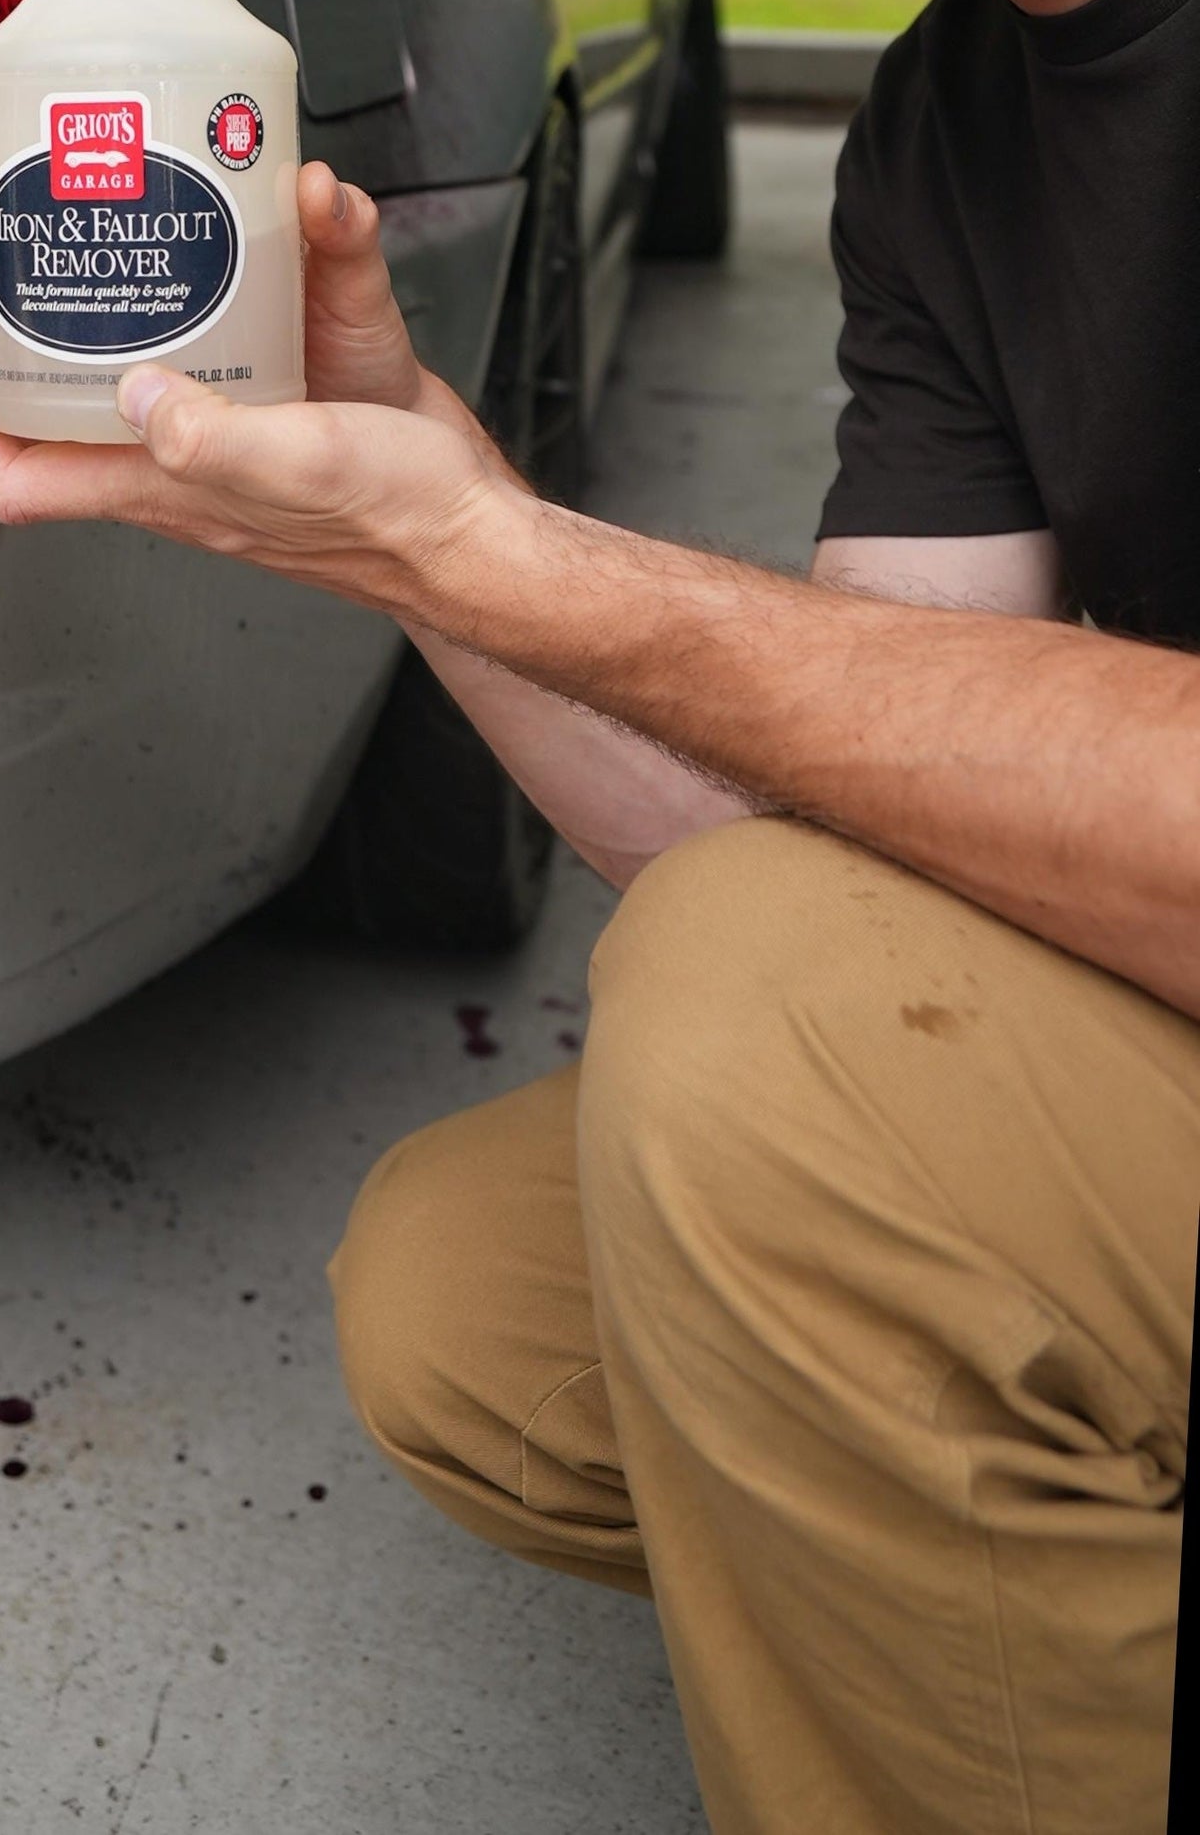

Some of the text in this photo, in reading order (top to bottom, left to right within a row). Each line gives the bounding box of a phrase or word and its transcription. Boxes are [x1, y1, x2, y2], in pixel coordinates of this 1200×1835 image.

[221, 95, 261, 123] BALANCED
[58, 107, 136, 145] GRIOT'S
[225, 114, 250, 132] SURFACE
[226, 132, 251, 152] PREP
[212, 144, 250, 169] CLINGING
[61, 174, 135, 189] GARAGE
[58, 207, 87, 242] &
[90, 208, 217, 242] FALLOUT
[31, 242, 172, 278] REMOVER
[16, 282, 191, 300] Thick formula quickly & safely
[21, 299, 184, 315] decontaminates all surfaces
